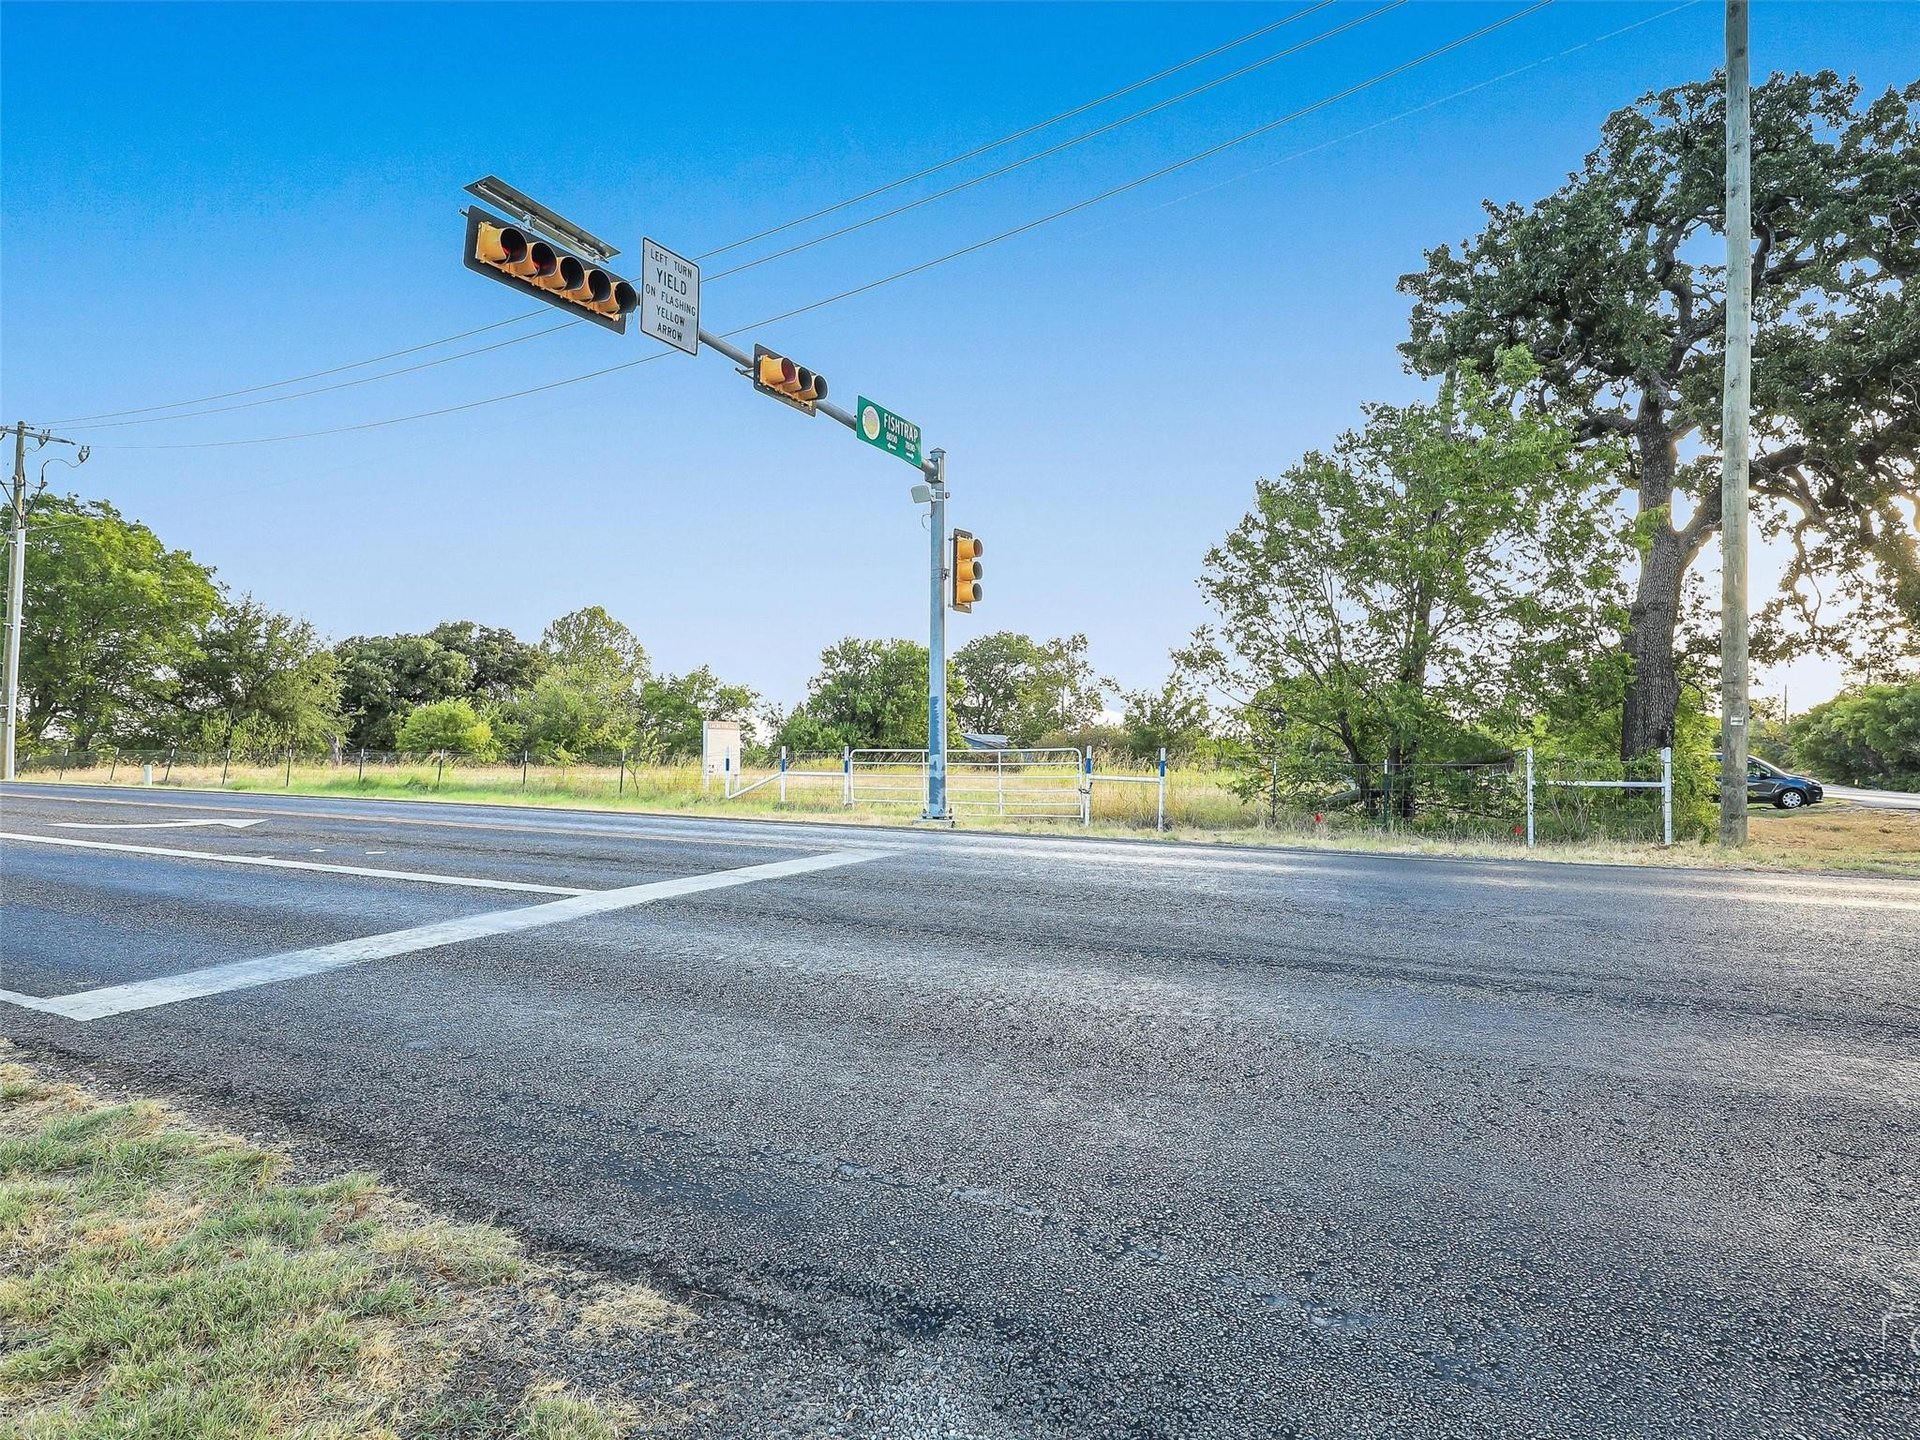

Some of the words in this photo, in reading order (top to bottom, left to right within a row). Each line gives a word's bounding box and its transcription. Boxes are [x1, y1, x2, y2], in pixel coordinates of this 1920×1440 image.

[650, 248, 668, 265] LEFT
[674, 261, 692, 279] TURN
[656, 268, 686, 295] YIELD
[645, 284, 656, 297] ON
[661, 292, 696, 316] FLASHING
[656, 305, 685, 326] YELLOW
[657, 322, 683, 342] ARROW
[883, 413, 918, 442] FISHTRAP
